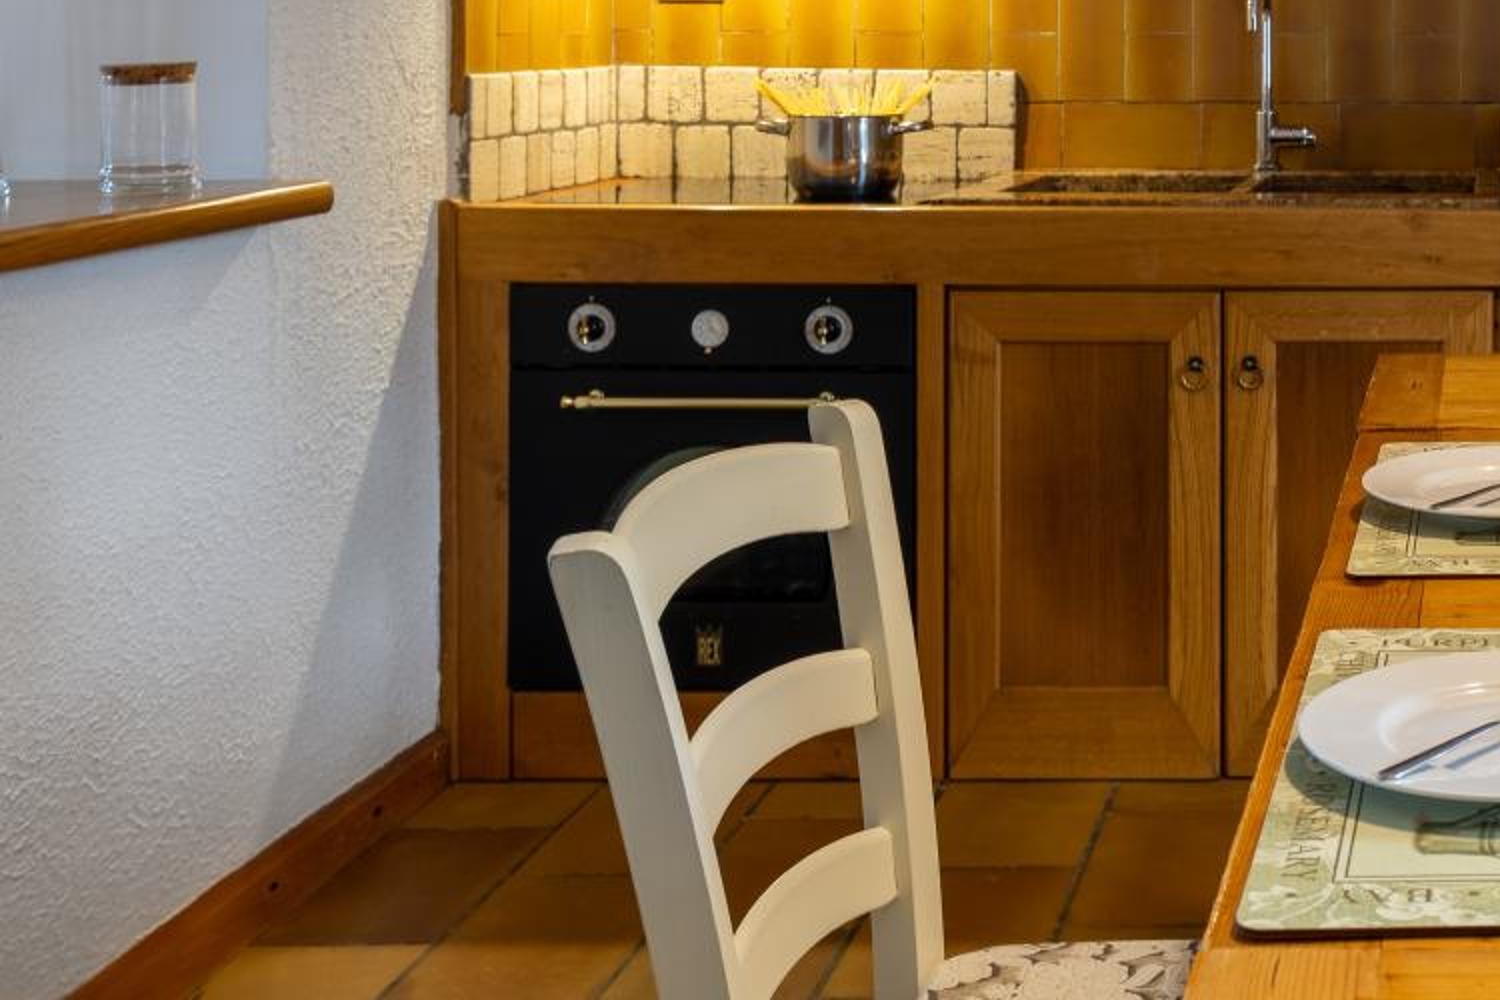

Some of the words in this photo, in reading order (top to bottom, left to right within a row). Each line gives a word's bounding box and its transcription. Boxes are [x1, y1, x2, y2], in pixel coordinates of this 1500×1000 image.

[697, 636, 721, 666] REX
[1281, 782, 1338, 884] ROSEMARY
[1341, 886, 1434, 904] BAY
